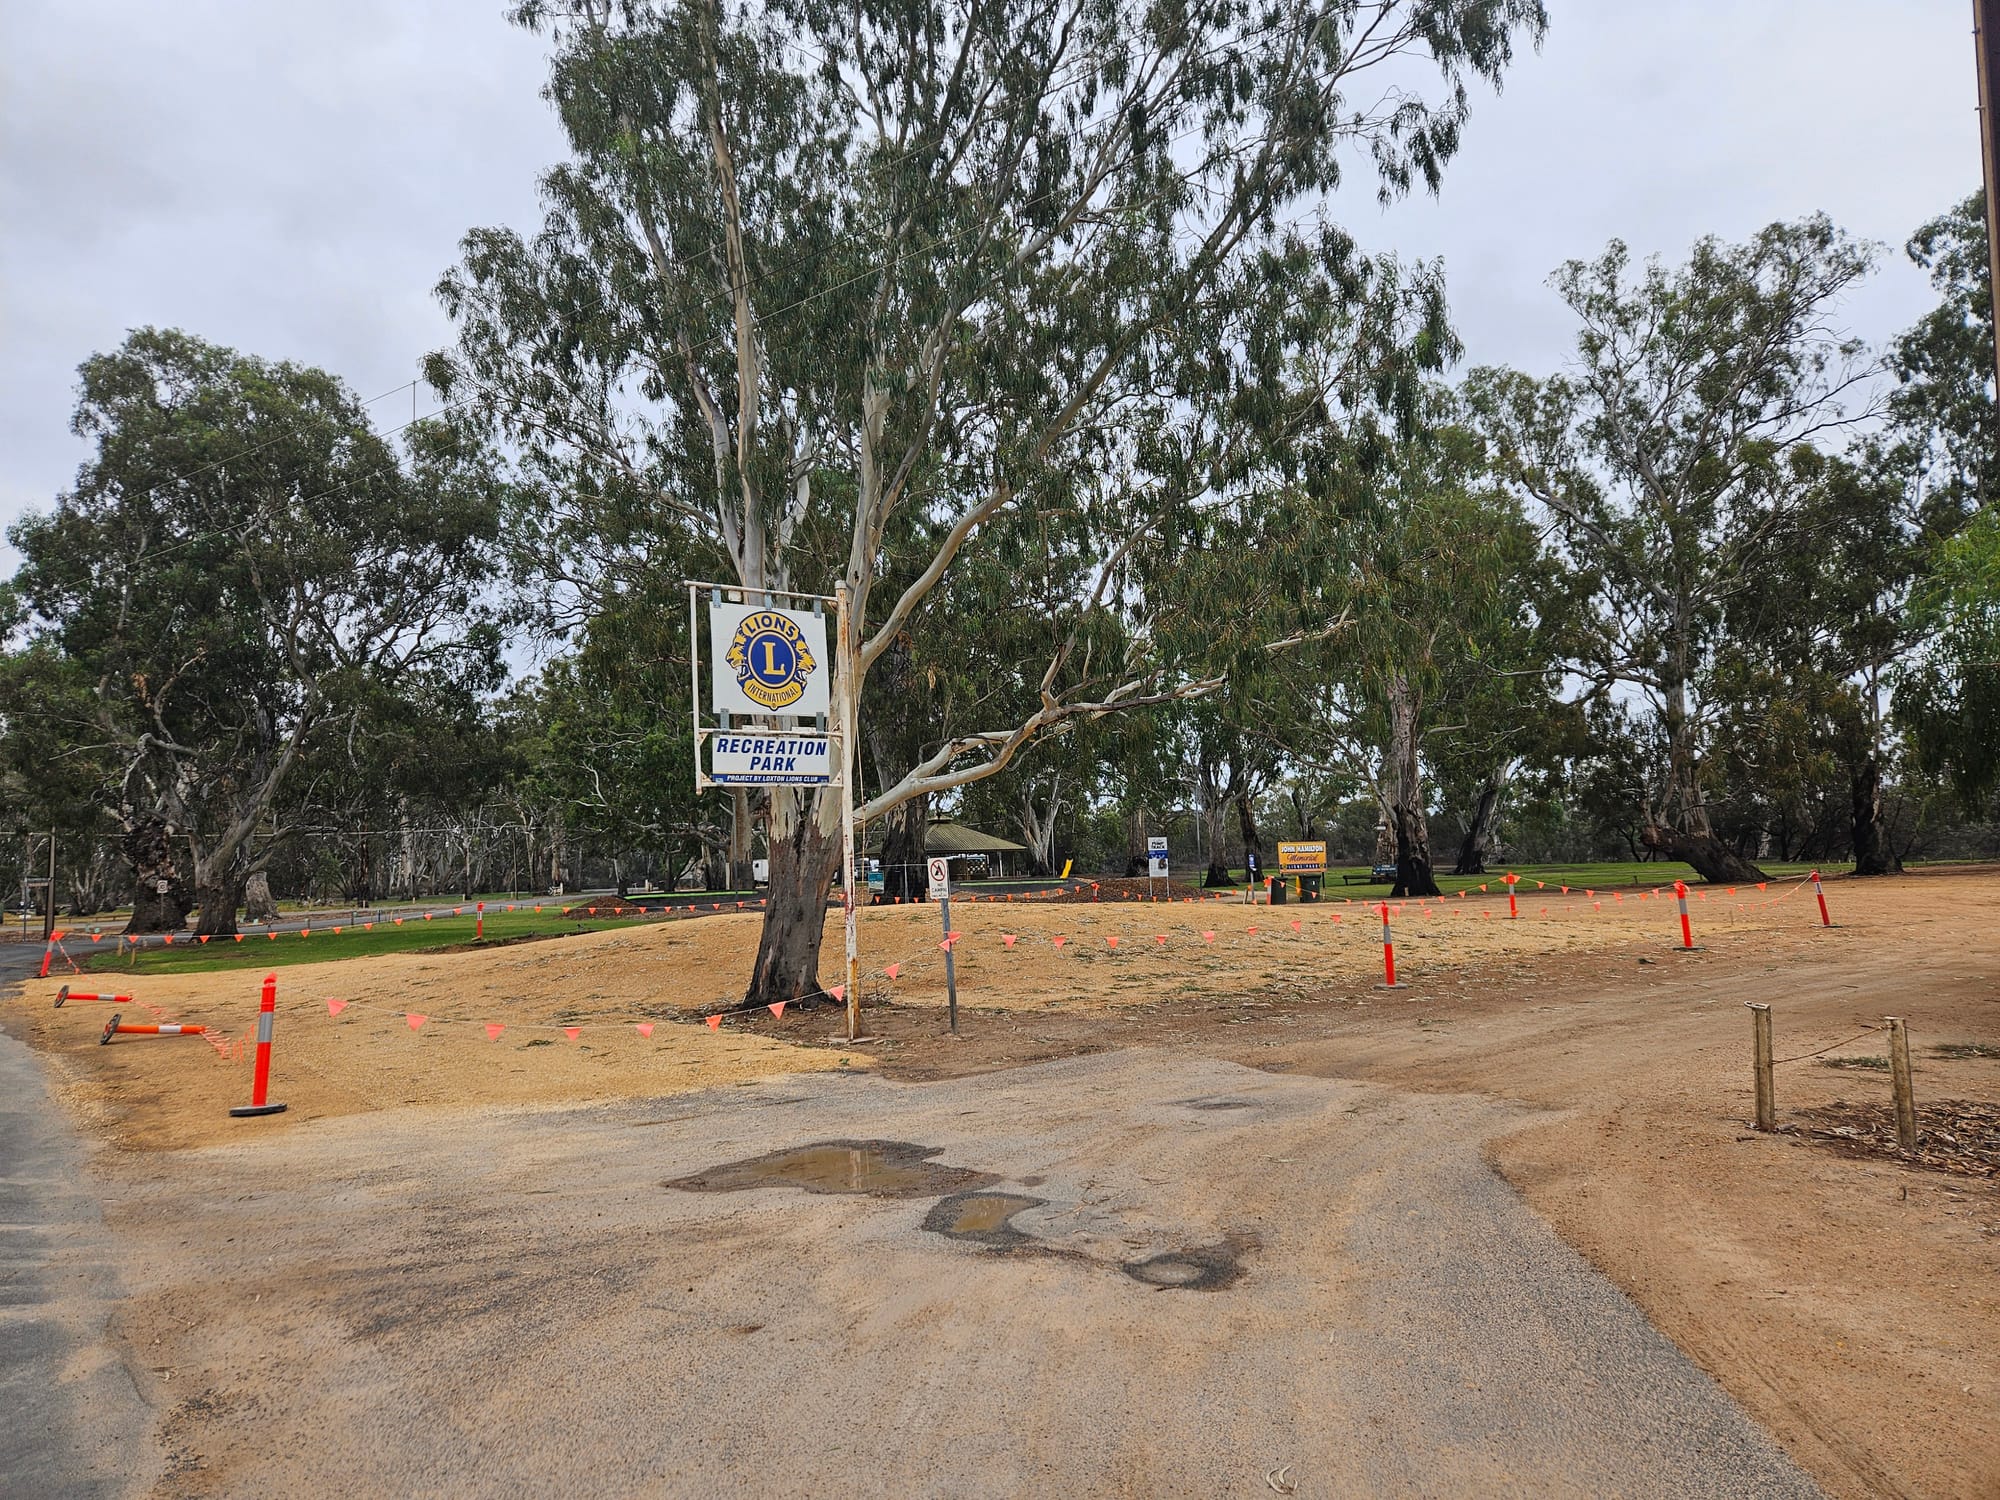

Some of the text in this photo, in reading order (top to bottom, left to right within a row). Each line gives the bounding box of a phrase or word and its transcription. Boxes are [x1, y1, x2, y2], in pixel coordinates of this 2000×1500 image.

[745, 615, 796, 638] LIONS
[762, 641, 786, 676] L
[748, 683, 799, 703] INTERNATIONAL
[717, 738, 827, 755] RECREATION
[750, 756, 796, 771] PARK
[1287, 854, 1319, 862] Memorial
